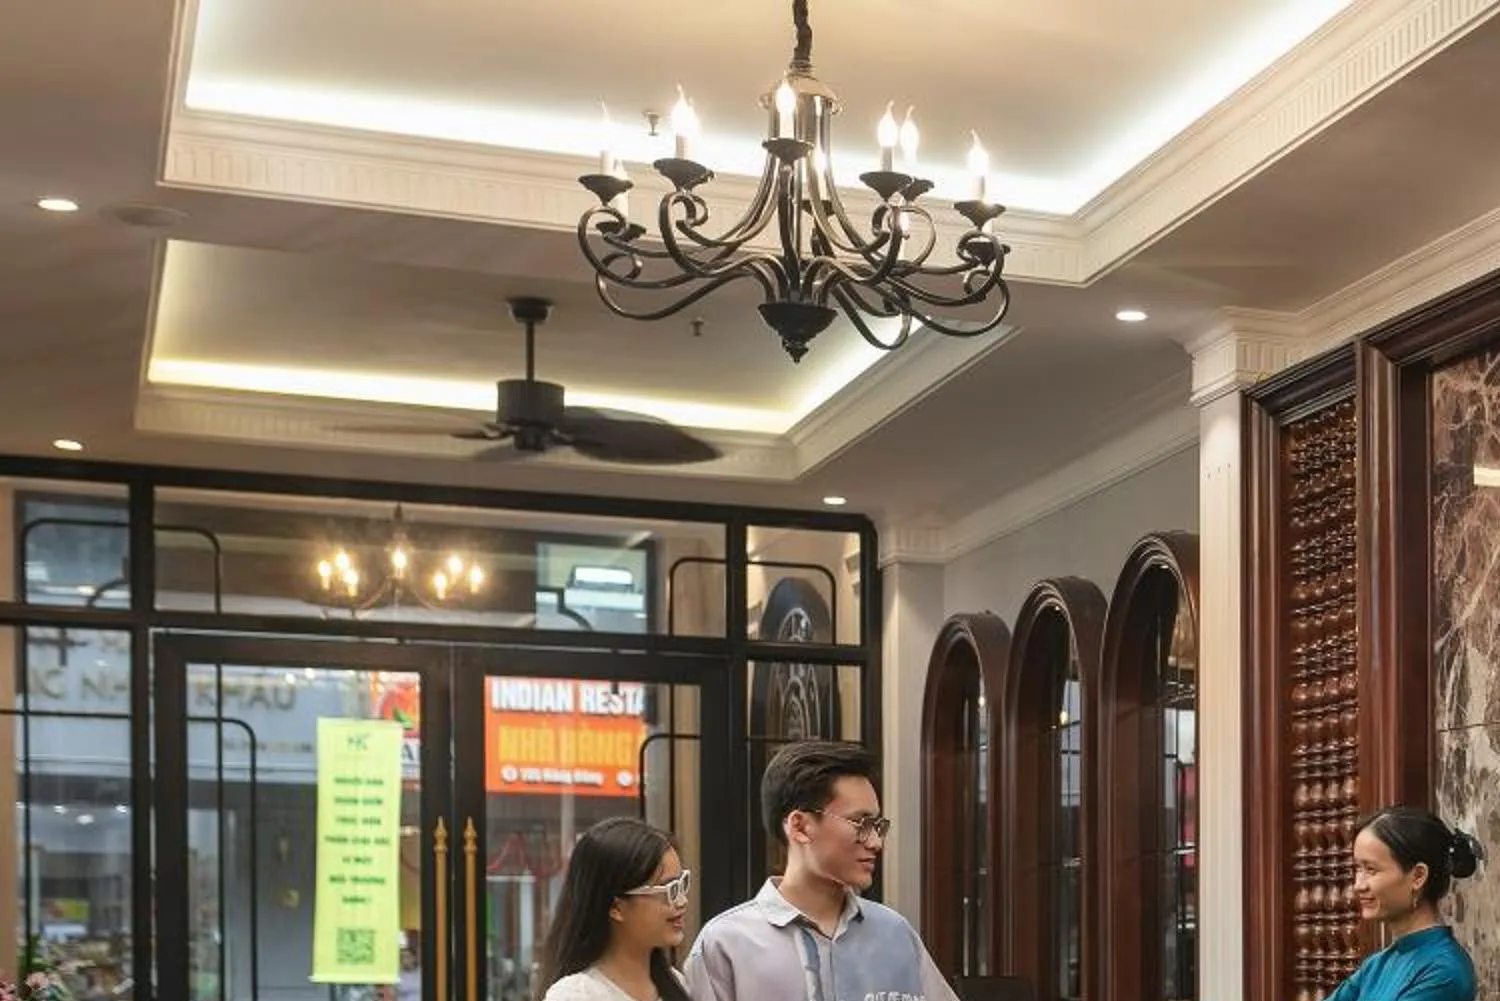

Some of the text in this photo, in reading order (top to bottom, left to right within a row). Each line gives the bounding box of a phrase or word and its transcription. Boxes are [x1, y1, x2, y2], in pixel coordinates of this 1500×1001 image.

[491, 677, 573, 712] INDIAN
[499, 720, 555, 765] NHÀ
[559, 721, 633, 767] HÀNG
